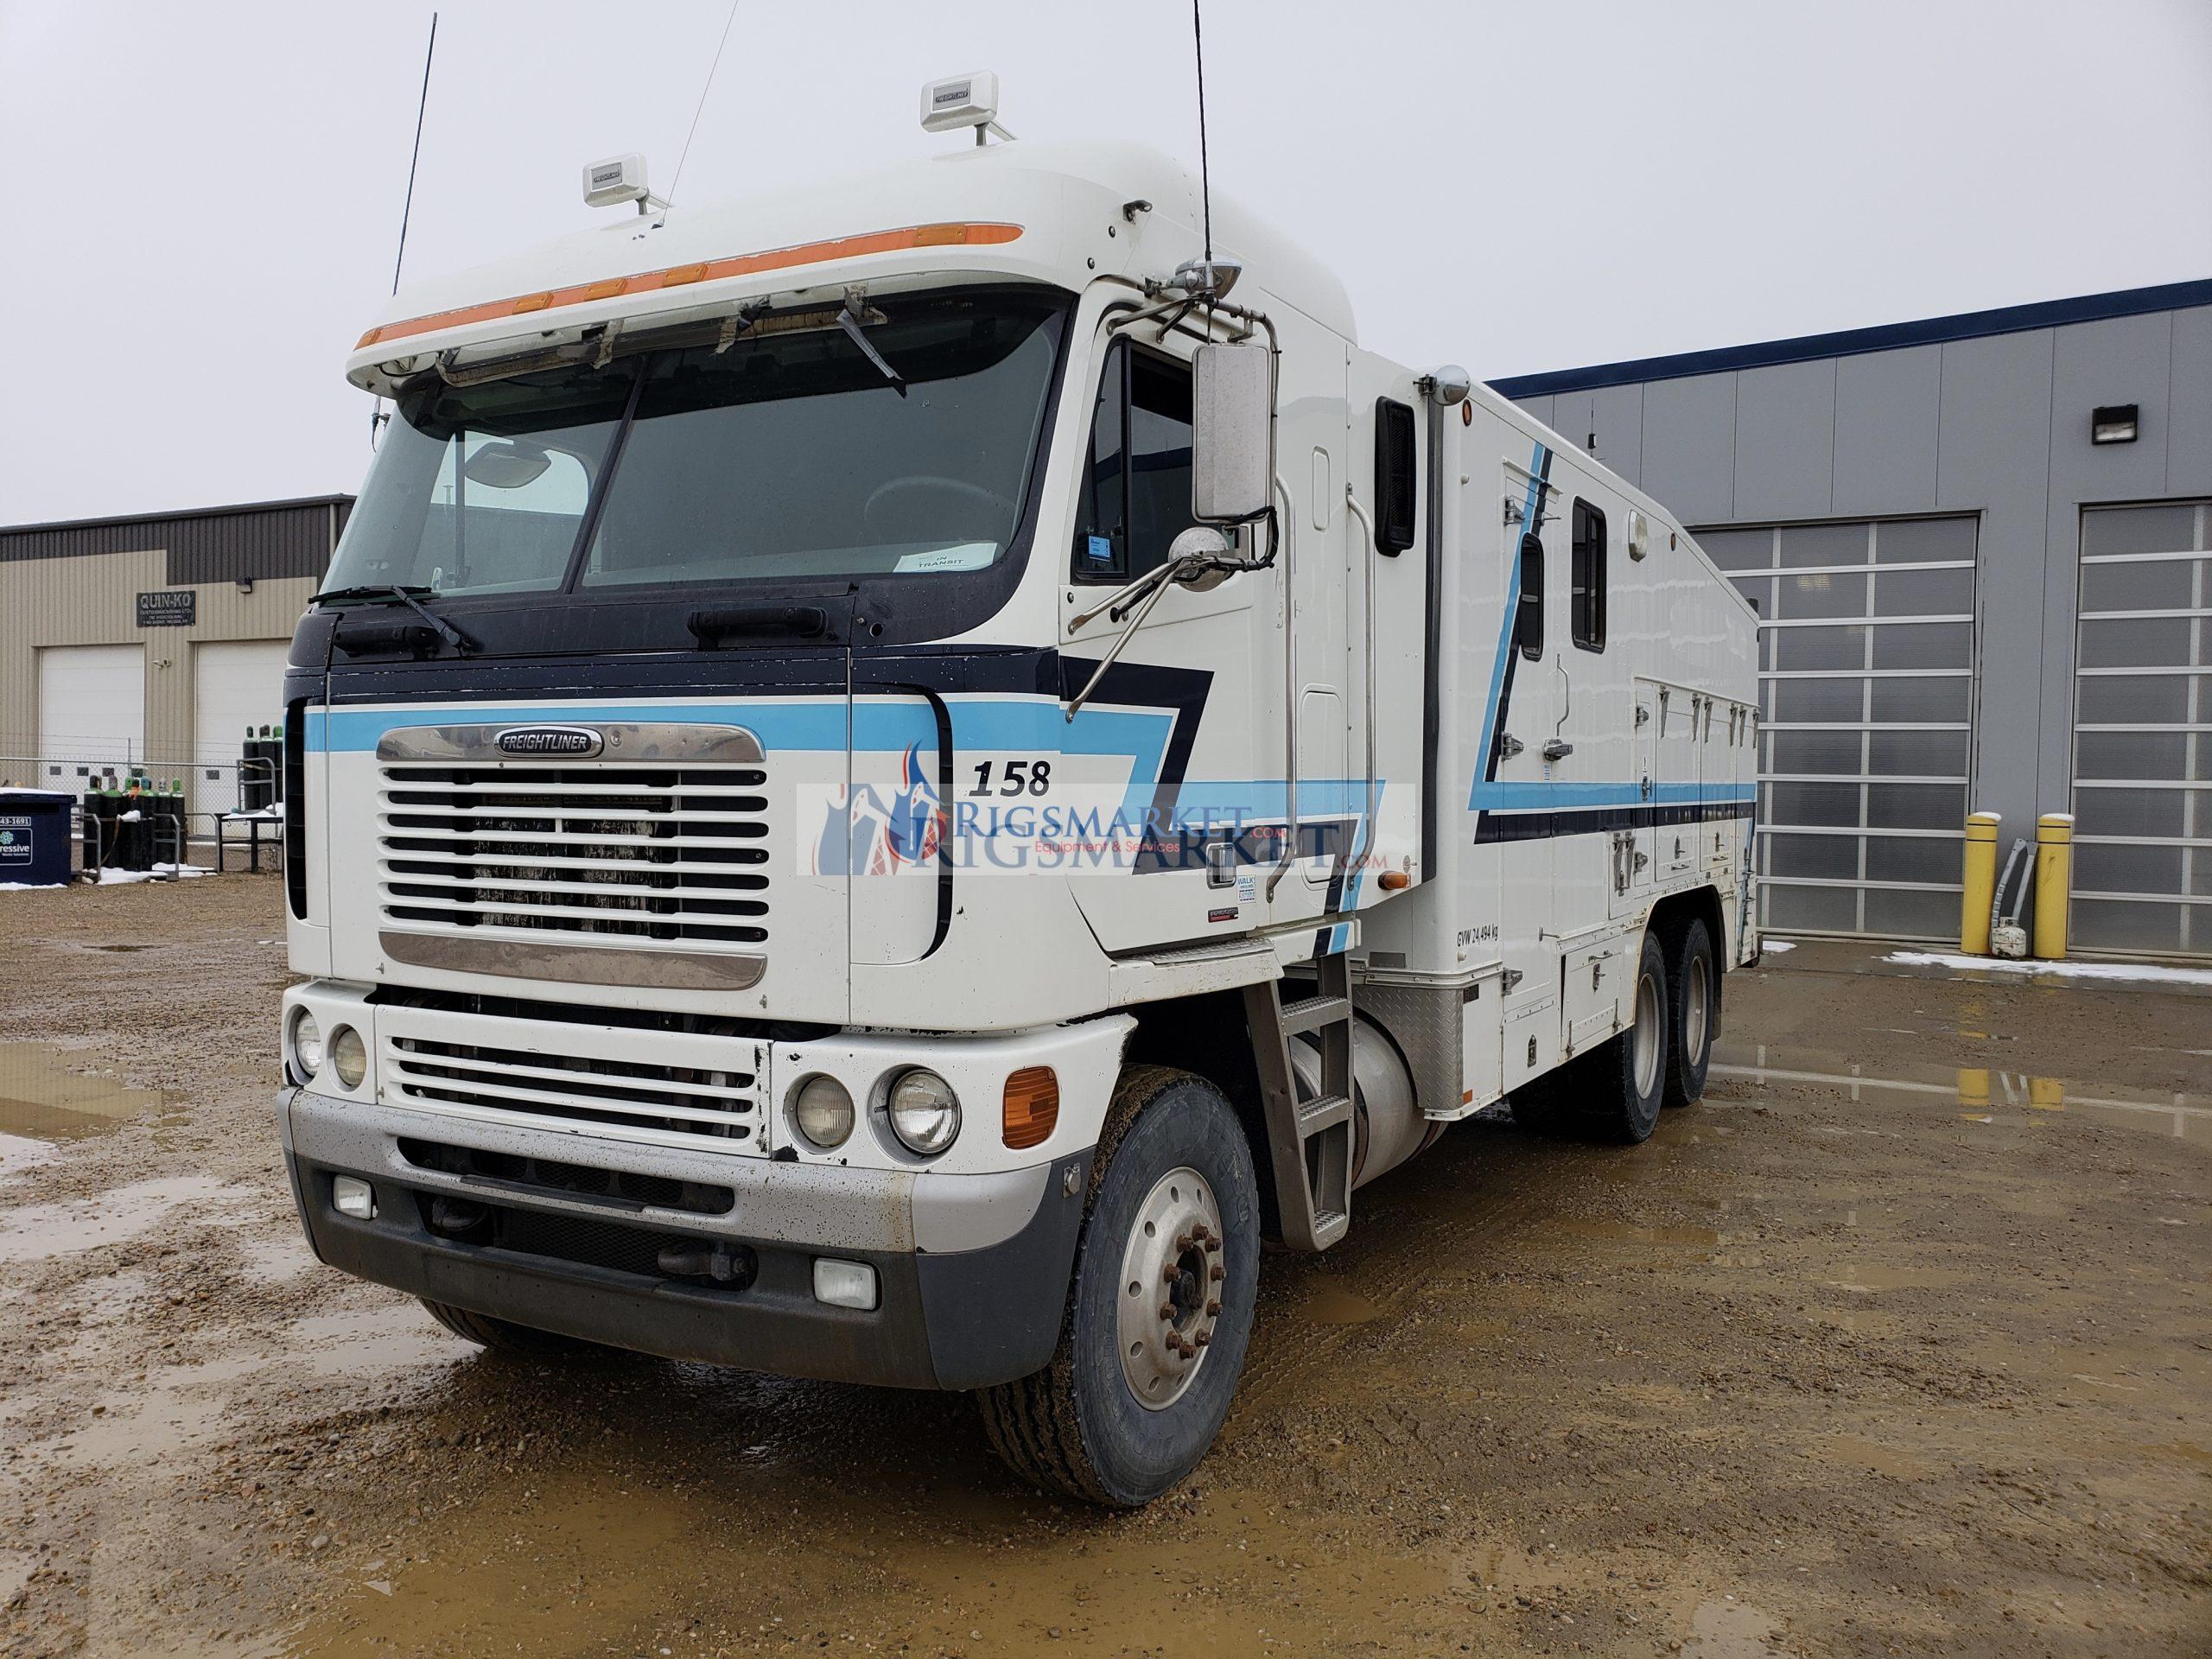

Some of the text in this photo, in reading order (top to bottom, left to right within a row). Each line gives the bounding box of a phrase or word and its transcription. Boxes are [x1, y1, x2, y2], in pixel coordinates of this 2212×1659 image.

[918, 559, 963, 568] TRANSIT
[140, 594, 191, 609] QUIN-KO
[503, 734, 588, 750] FREIGHTLINER
[968, 760, 1051, 797] 158
[1457, 929, 1471, 947] GVW
[1491, 923, 1498, 942] kg
